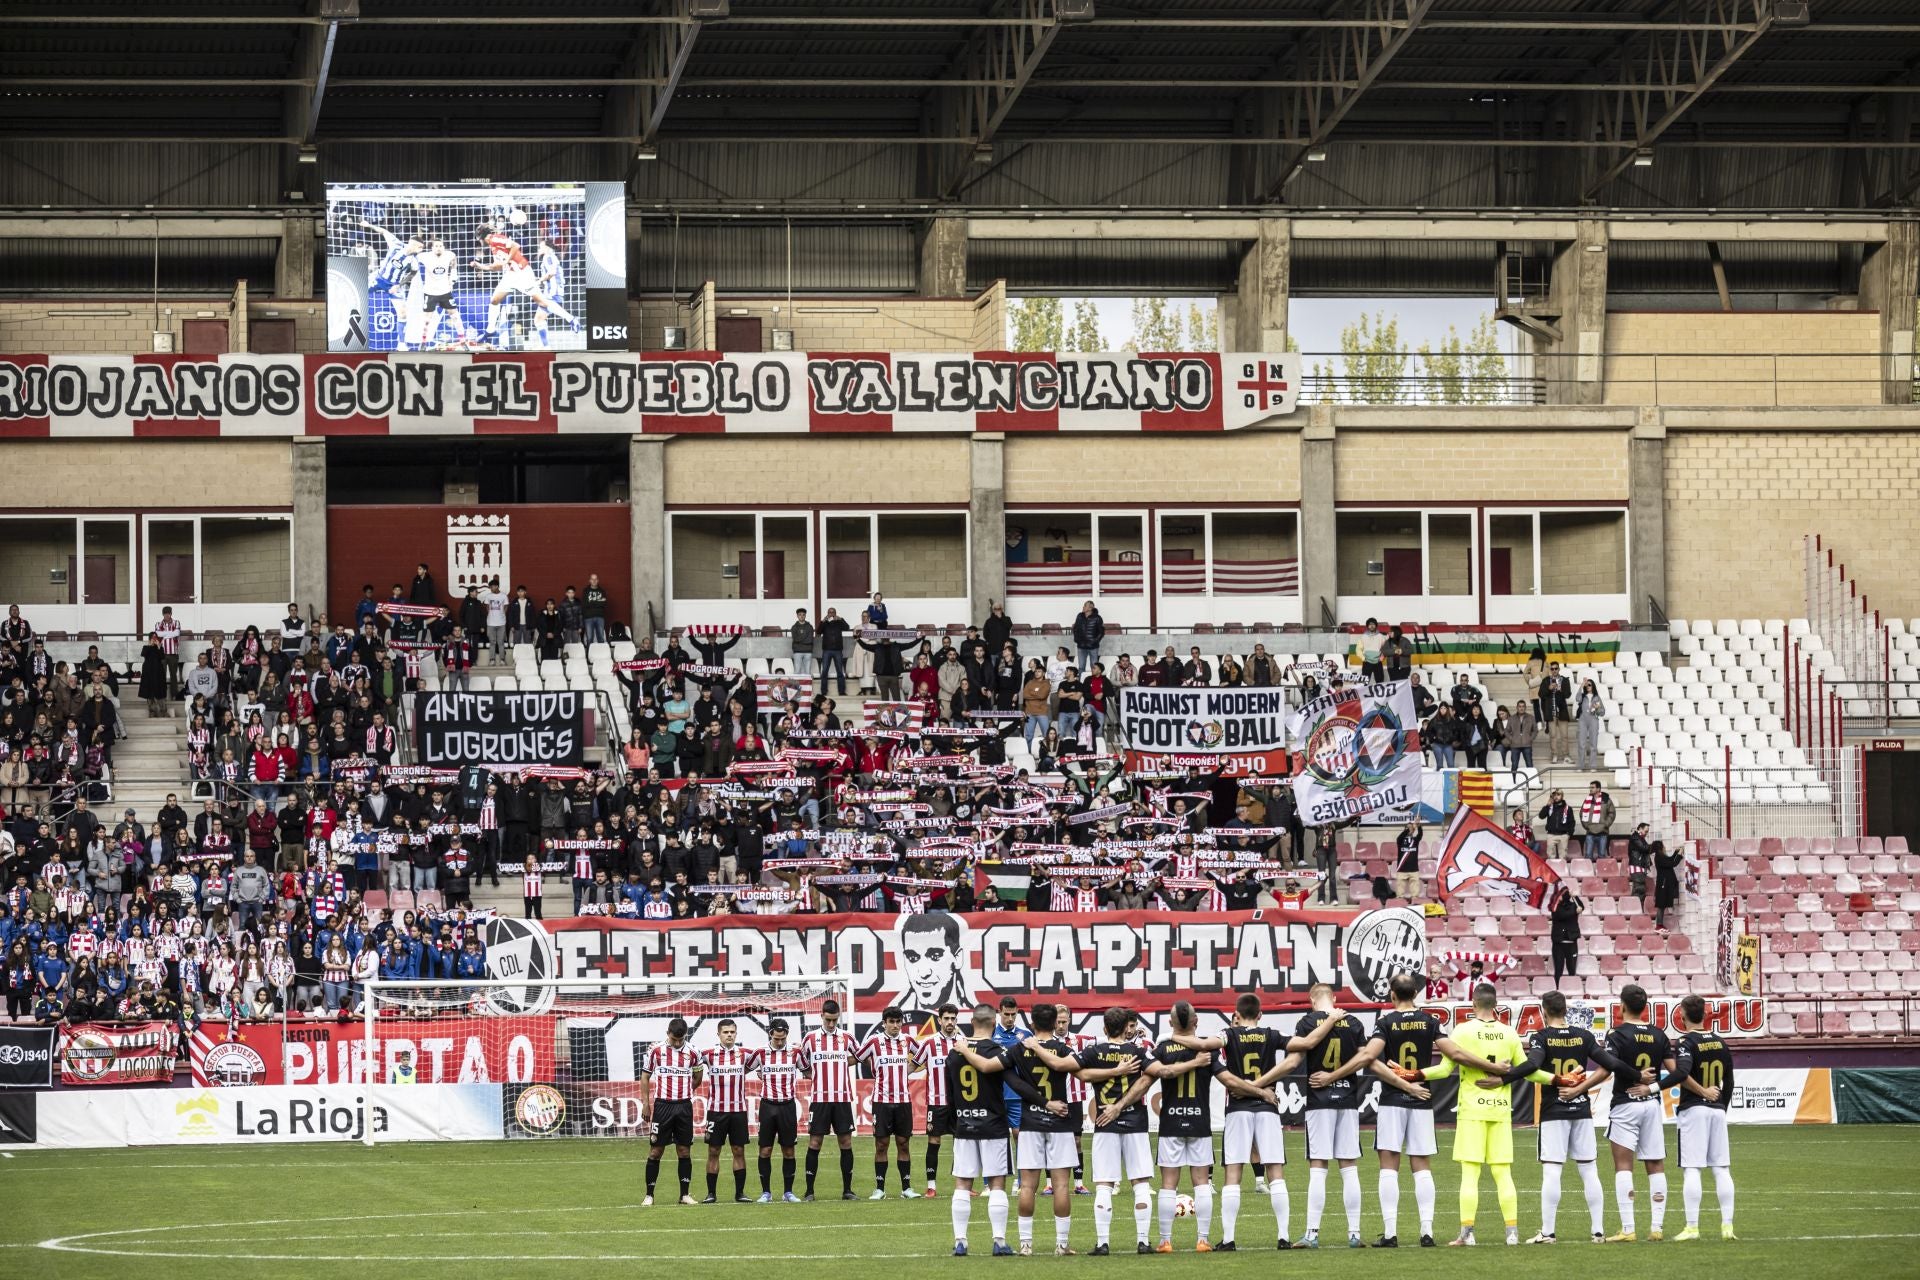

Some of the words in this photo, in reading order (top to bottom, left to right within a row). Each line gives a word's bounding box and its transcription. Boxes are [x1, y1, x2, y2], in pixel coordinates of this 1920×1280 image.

[1243, 364, 1254, 378] G
[1270, 364, 1283, 379] N
[317, 361, 443, 418] CON
[460, 363, 540, 417] EL
[551, 360, 791, 414] PUEBLO
[808, 359, 1212, 414] VALENCIANO
[424, 693, 494, 723] ANTE
[504, 692, 575, 723] TODO
[1125, 692, 1200, 716] AGAINST
[1207, 692, 1280, 714] MODERN
[426, 726, 573, 762] LOGROÑÉS
[1126, 719, 1187, 747] FOOT
[1225, 718, 1281, 747] BALL
[1875, 741, 1902, 749] SALIDA
[1224, 756, 1267, 775] 940
[554, 925, 888, 996] ETERNO
[982, 908, 1341, 994] CAPITÁN
[1400, 1021, 1427, 1031] UGARTE
[24, 1049, 48, 1061] 1940
[1322, 1037, 1341, 1073] 4
[1399, 1041, 1418, 1070] 6
[1547, 1036, 1583, 1047] CABALLERO
[1174, 1061, 1196, 1098] 11
[1243, 1052, 1262, 1081] 5
[1700, 1059, 1724, 1088] 10
[959, 1064, 979, 1102] 9
[1031, 1066, 1053, 1101] 3
[236, 1100, 279, 1136] La
[290, 1096, 389, 1140] Rioja
